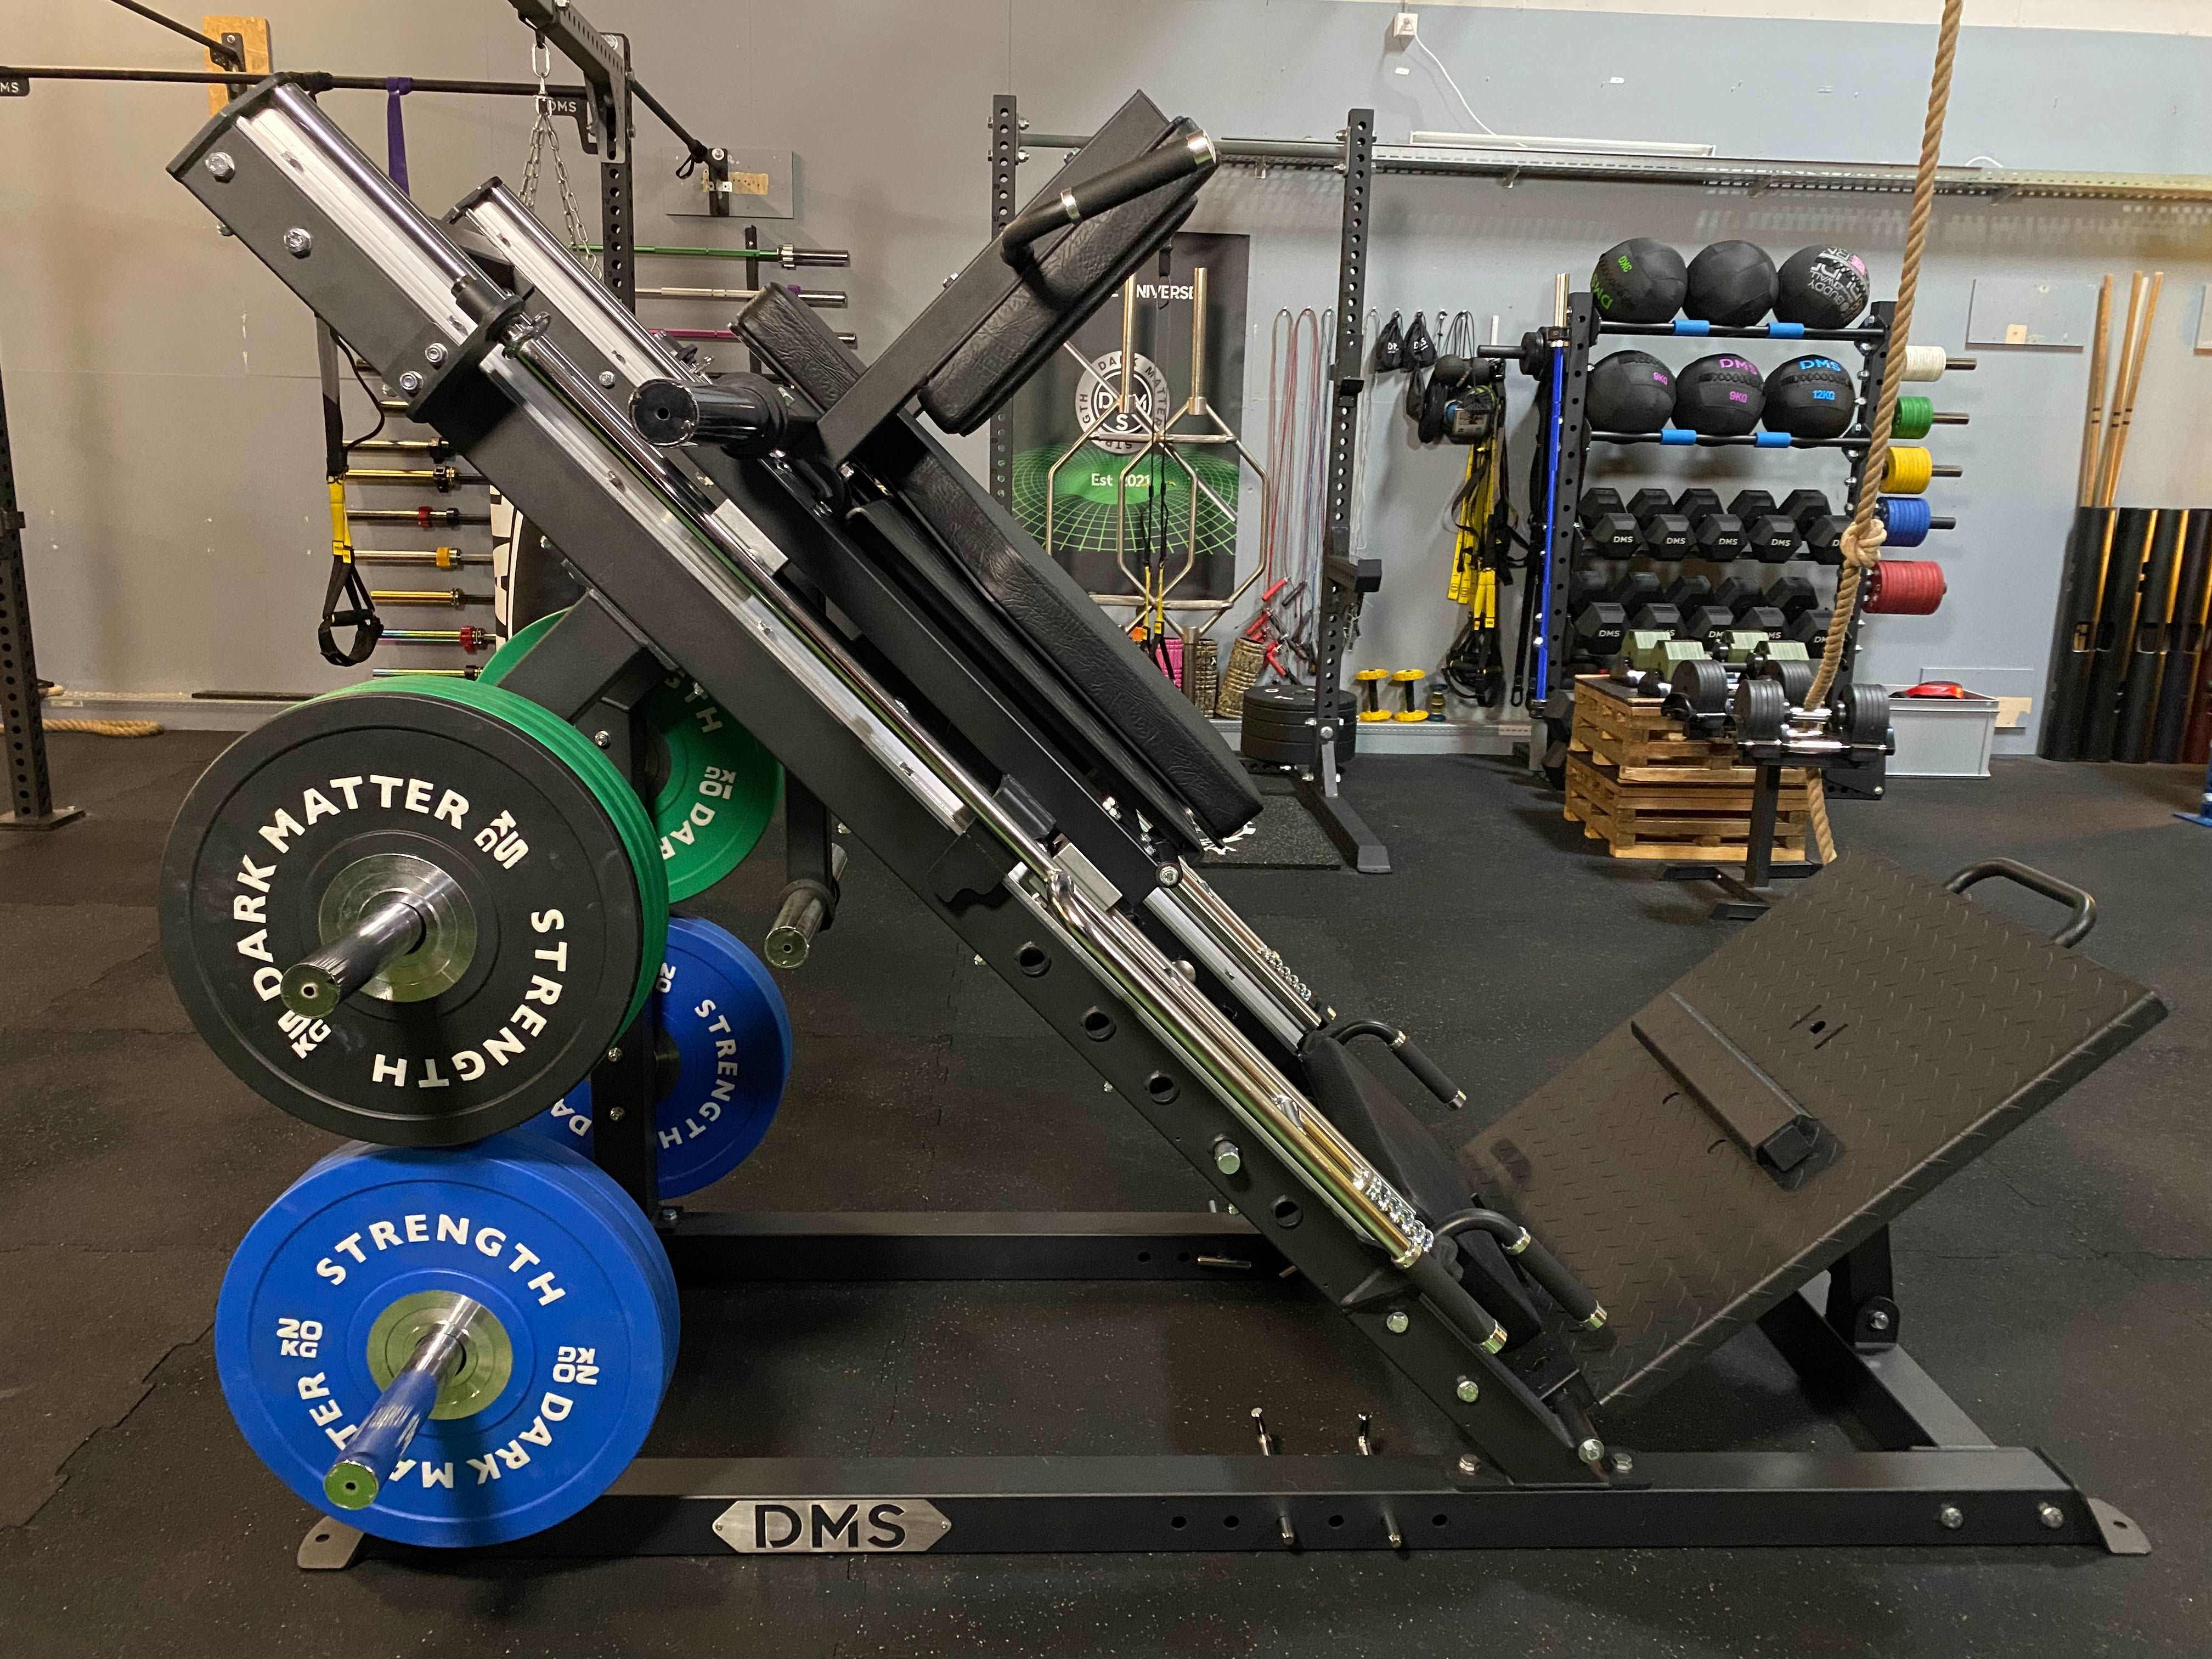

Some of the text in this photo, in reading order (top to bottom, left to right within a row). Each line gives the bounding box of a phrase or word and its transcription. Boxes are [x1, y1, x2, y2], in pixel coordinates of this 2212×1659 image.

[0, 82, 19, 93] MS
[1136, 284, 1194, 300] NIVERSE
[1719, 359, 1757, 375] DMS
[1799, 359, 1841, 371] DMS
[1729, 391, 1747, 403] 9KG
[1813, 390, 1835, 400] 12KG
[1091, 473, 1150, 487] Est 021
[659, 802, 715, 860] DAR
[233, 774, 470, 1002] DARK MATTER
[372, 909, 568, 1088] STRENGTH
[658, 999, 738, 1149] STRENGTH
[550, 1098, 592, 1137] DA
[315, 1214, 567, 1307] STRENGTH
[276, 1318, 323, 1341] 20
[280, 1340, 318, 1359] KG
[557, 1346, 596, 1364] KG
[552, 1363, 600, 1385] 20
[298, 1372, 574, 1489] DARK MATER
[754, 1504, 906, 1548] DMS
